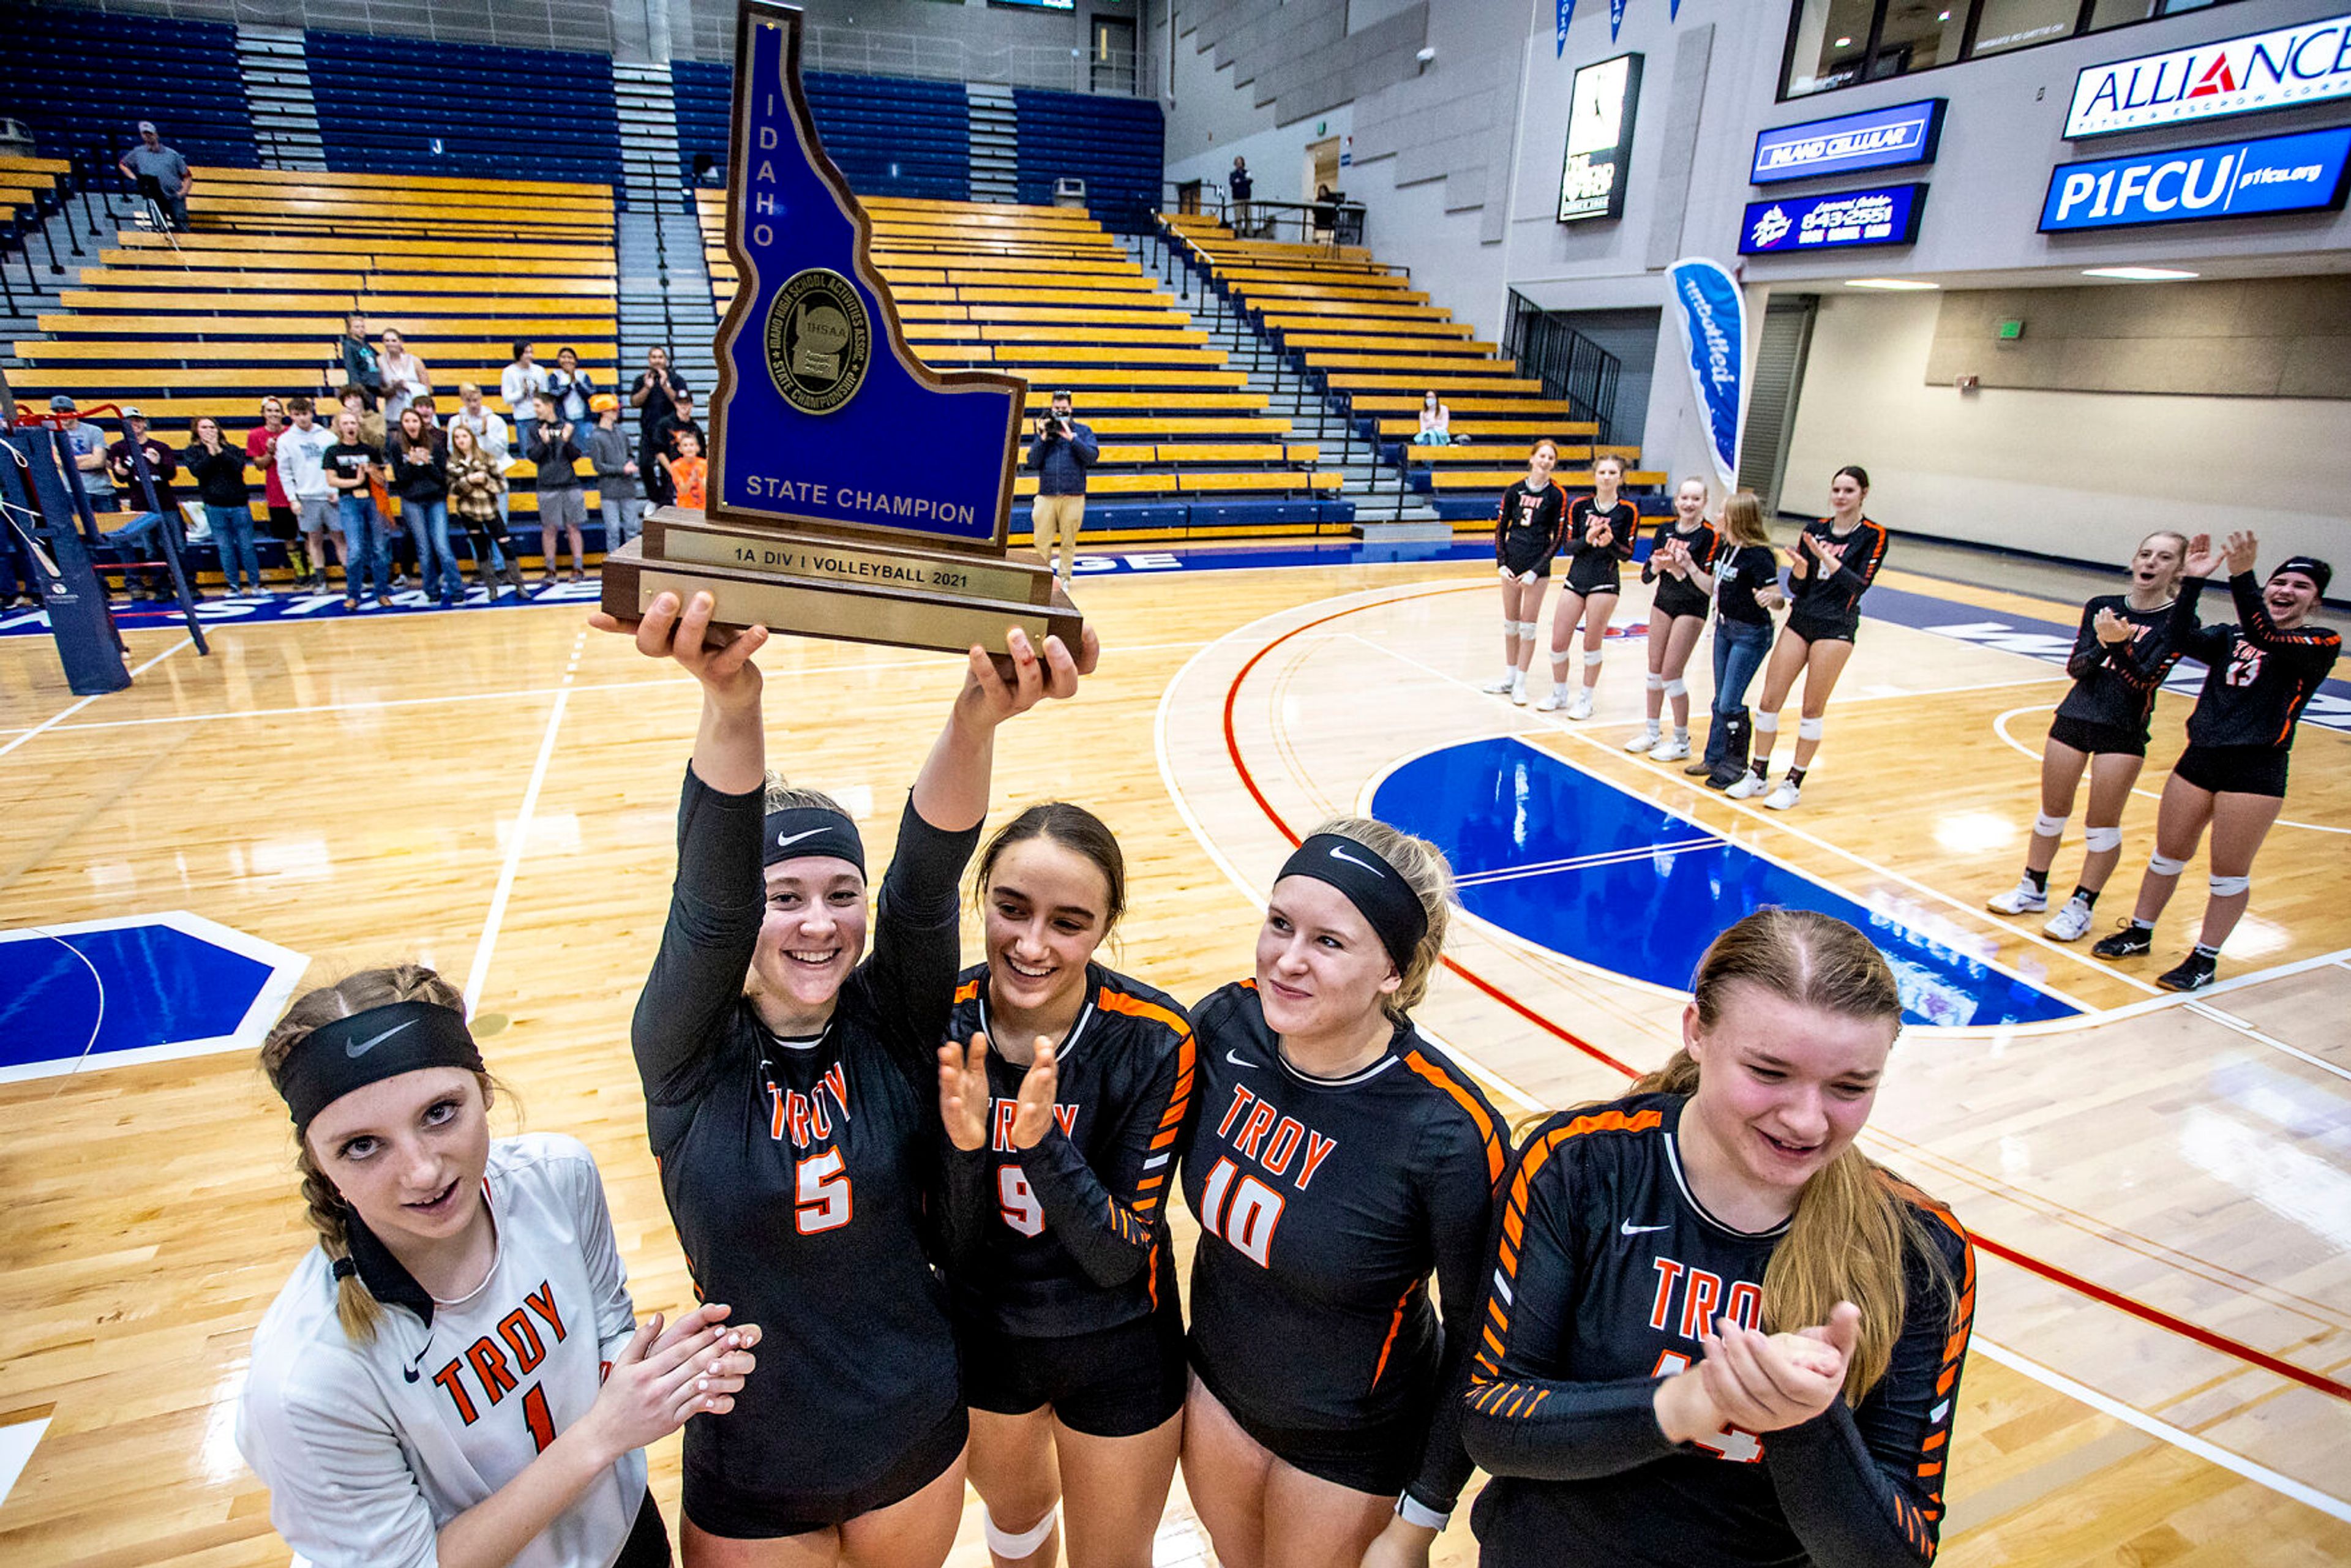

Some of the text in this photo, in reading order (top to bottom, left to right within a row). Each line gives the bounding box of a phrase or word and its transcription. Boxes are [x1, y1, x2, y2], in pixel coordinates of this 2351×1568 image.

[1558, 0, 1569, 41] 016
[2083, 26, 2351, 117] ALLIANCE
[2079, 114, 2134, 129] TITLE
[2173, 94, 2266, 116] ESCROW
[432, 138, 441, 154] J
[754, 94, 778, 246] IDAHO
[1769, 127, 1907, 165] INLAND CELLULAR
[2056, 154, 2323, 220] P1FCU p1fcu.org
[1801, 205, 1893, 230] 843-2551
[775, 292, 795, 317] HIGH
[791, 275, 826, 298] SCHOOL
[828, 277, 863, 328] ACTIVITIES
[770, 318, 783, 349] IDAHO
[806, 322, 846, 337] IHSAA
[773, 361, 793, 391] STATE
[792, 372, 857, 408] CHAMPIONSHIP
[746, 475, 975, 525] STATE CHAMPION
[1520, 508, 1532, 527] 3
[736, 548, 967, 588] 1A DIV I VOLLEYBALL 2021
[2226, 658, 2262, 686] 13
[767, 1061, 850, 1149] TROY
[988, 1098, 1079, 1153] RY
[1217, 1082, 1338, 1191] TROY
[795, 1144, 852, 1236] 5
[997, 1165, 1045, 1238] 9
[1201, 1155, 1285, 1269] 10
[1649, 1256, 1762, 1343] TRO
[432, 1278, 567, 1427] TROY
[522, 1380, 557, 1456] 1
